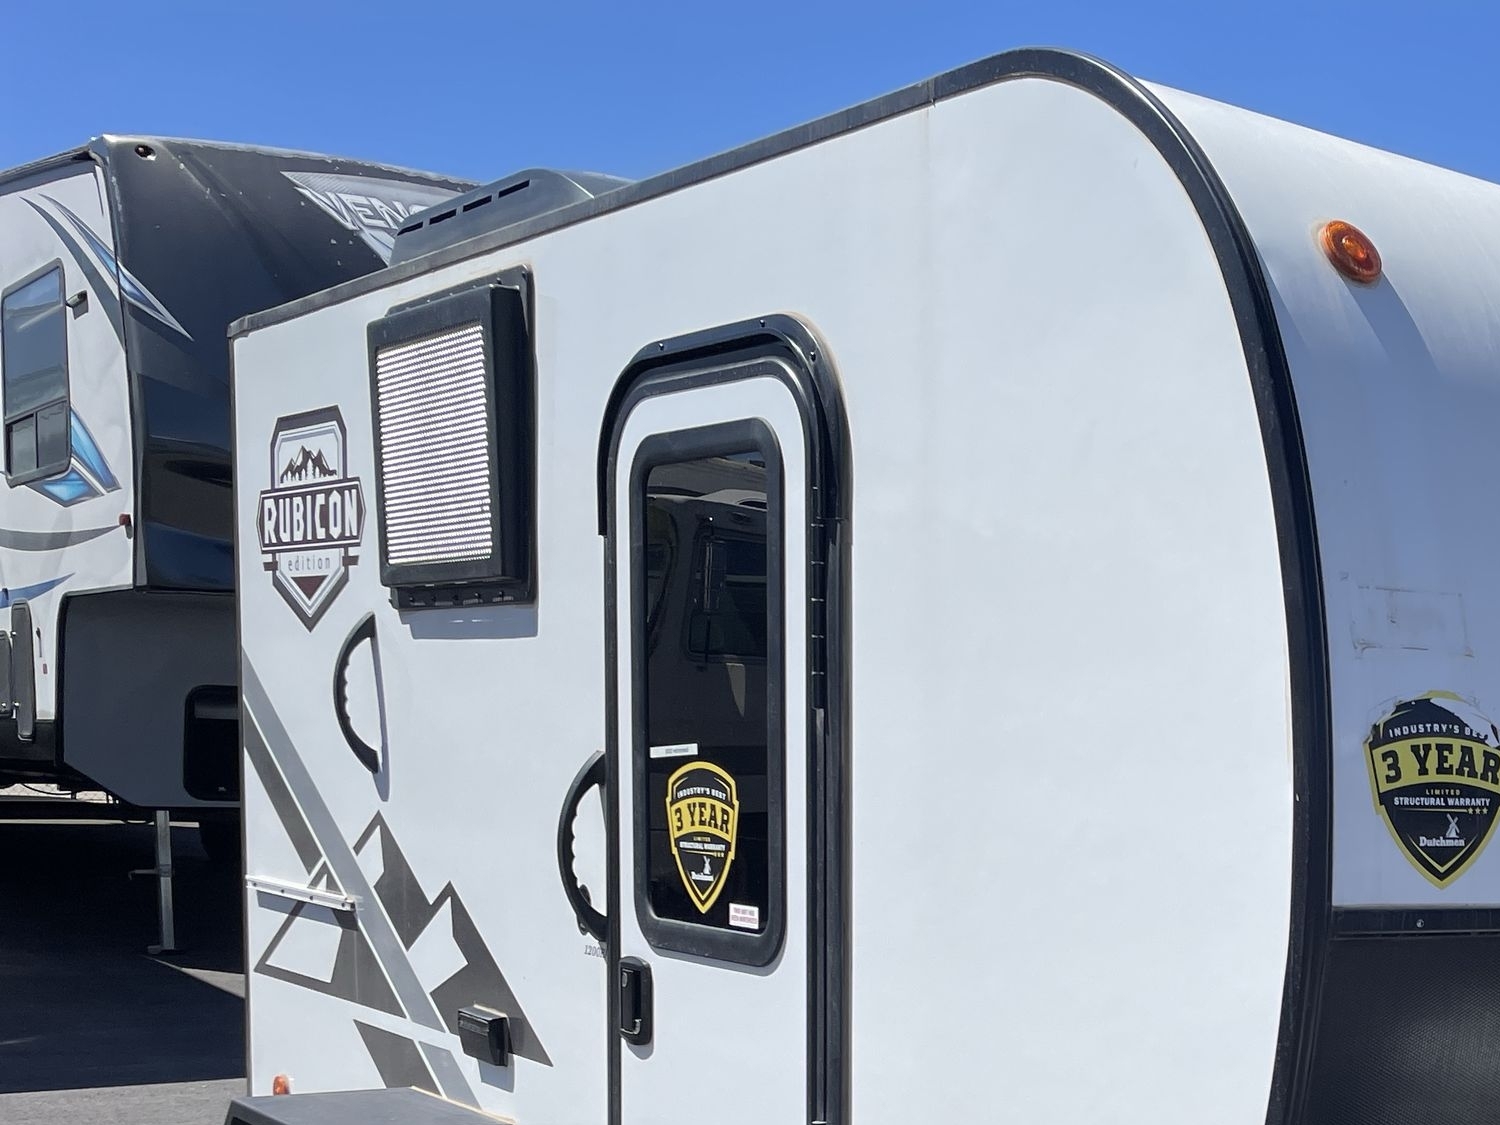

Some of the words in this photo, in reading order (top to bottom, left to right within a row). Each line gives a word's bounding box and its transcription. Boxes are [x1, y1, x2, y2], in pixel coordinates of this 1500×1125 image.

[263, 488, 358, 545] RUBICON
[287, 556, 331, 572] edition
[1388, 723, 1460, 738] INDUSTRY'S
[1381, 749, 1402, 784] 3
[1410, 742, 1500, 785] YEAR
[1425, 788, 1461, 796] LIMITED
[1393, 796, 1446, 806] STRUCTURAL
[1447, 797, 1491, 807] WARRANTY
[674, 806, 684, 832] 3
[687, 801, 730, 835] YEAR
